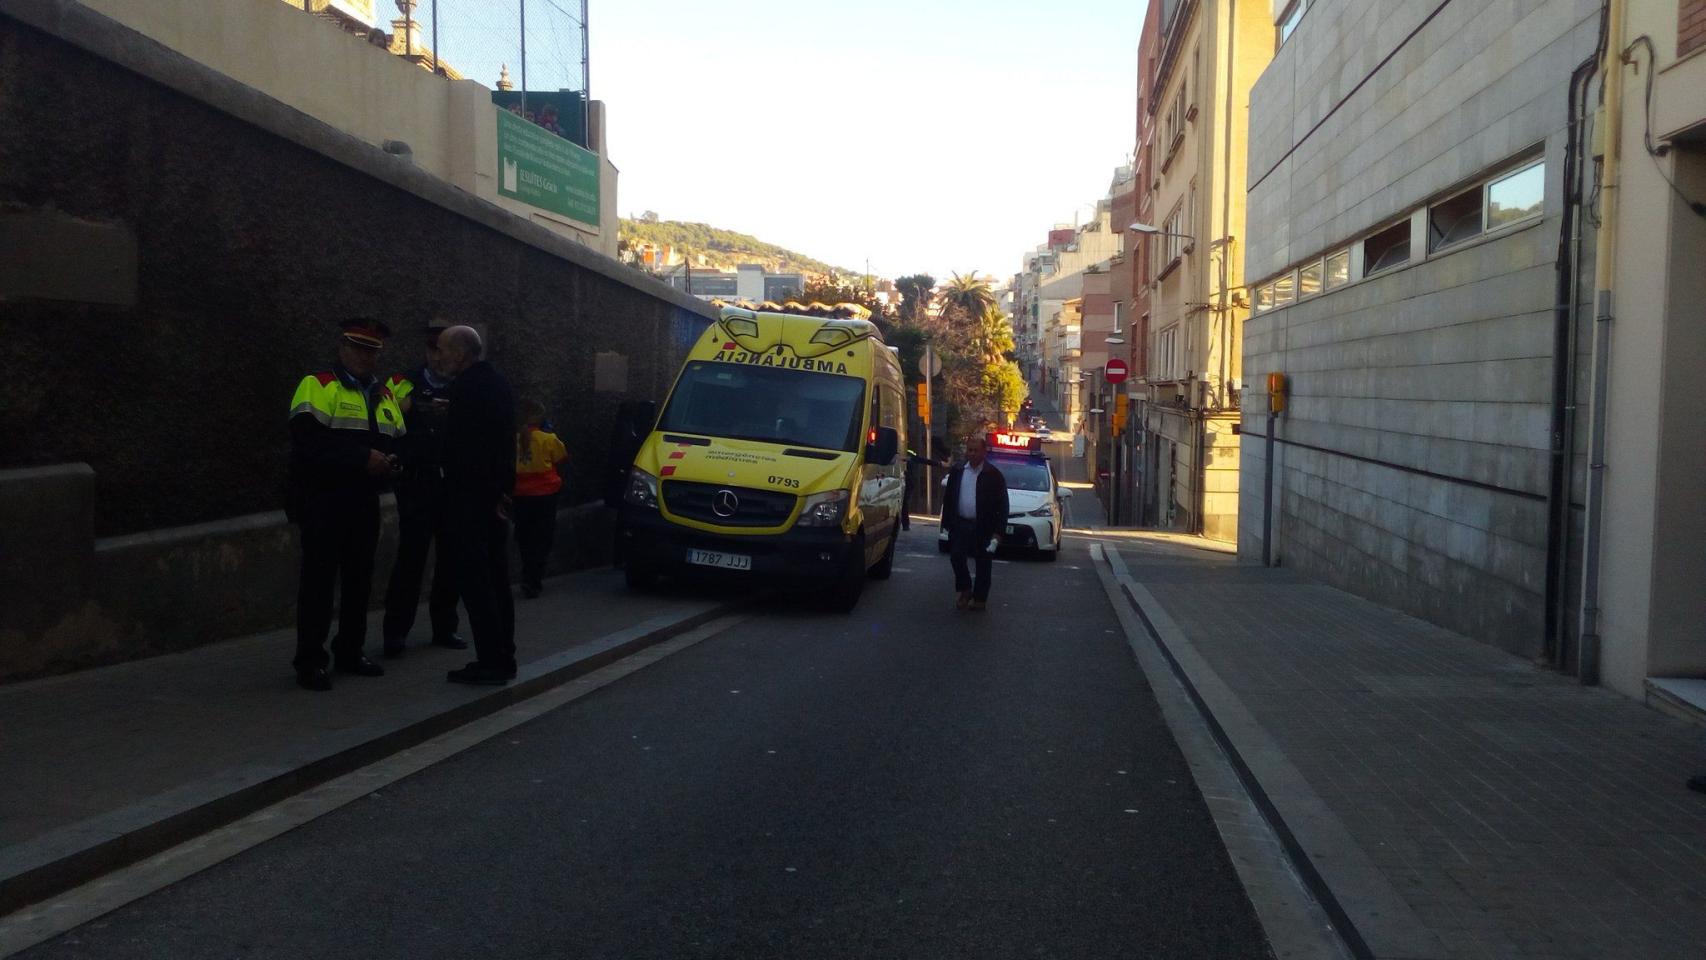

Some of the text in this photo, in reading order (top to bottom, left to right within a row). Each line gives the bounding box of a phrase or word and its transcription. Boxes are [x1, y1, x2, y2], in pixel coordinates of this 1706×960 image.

[996, 434, 1030, 447] TALLAT
[768, 475, 800, 488] 0793
[696, 551, 748, 568] 1787 JJJ
